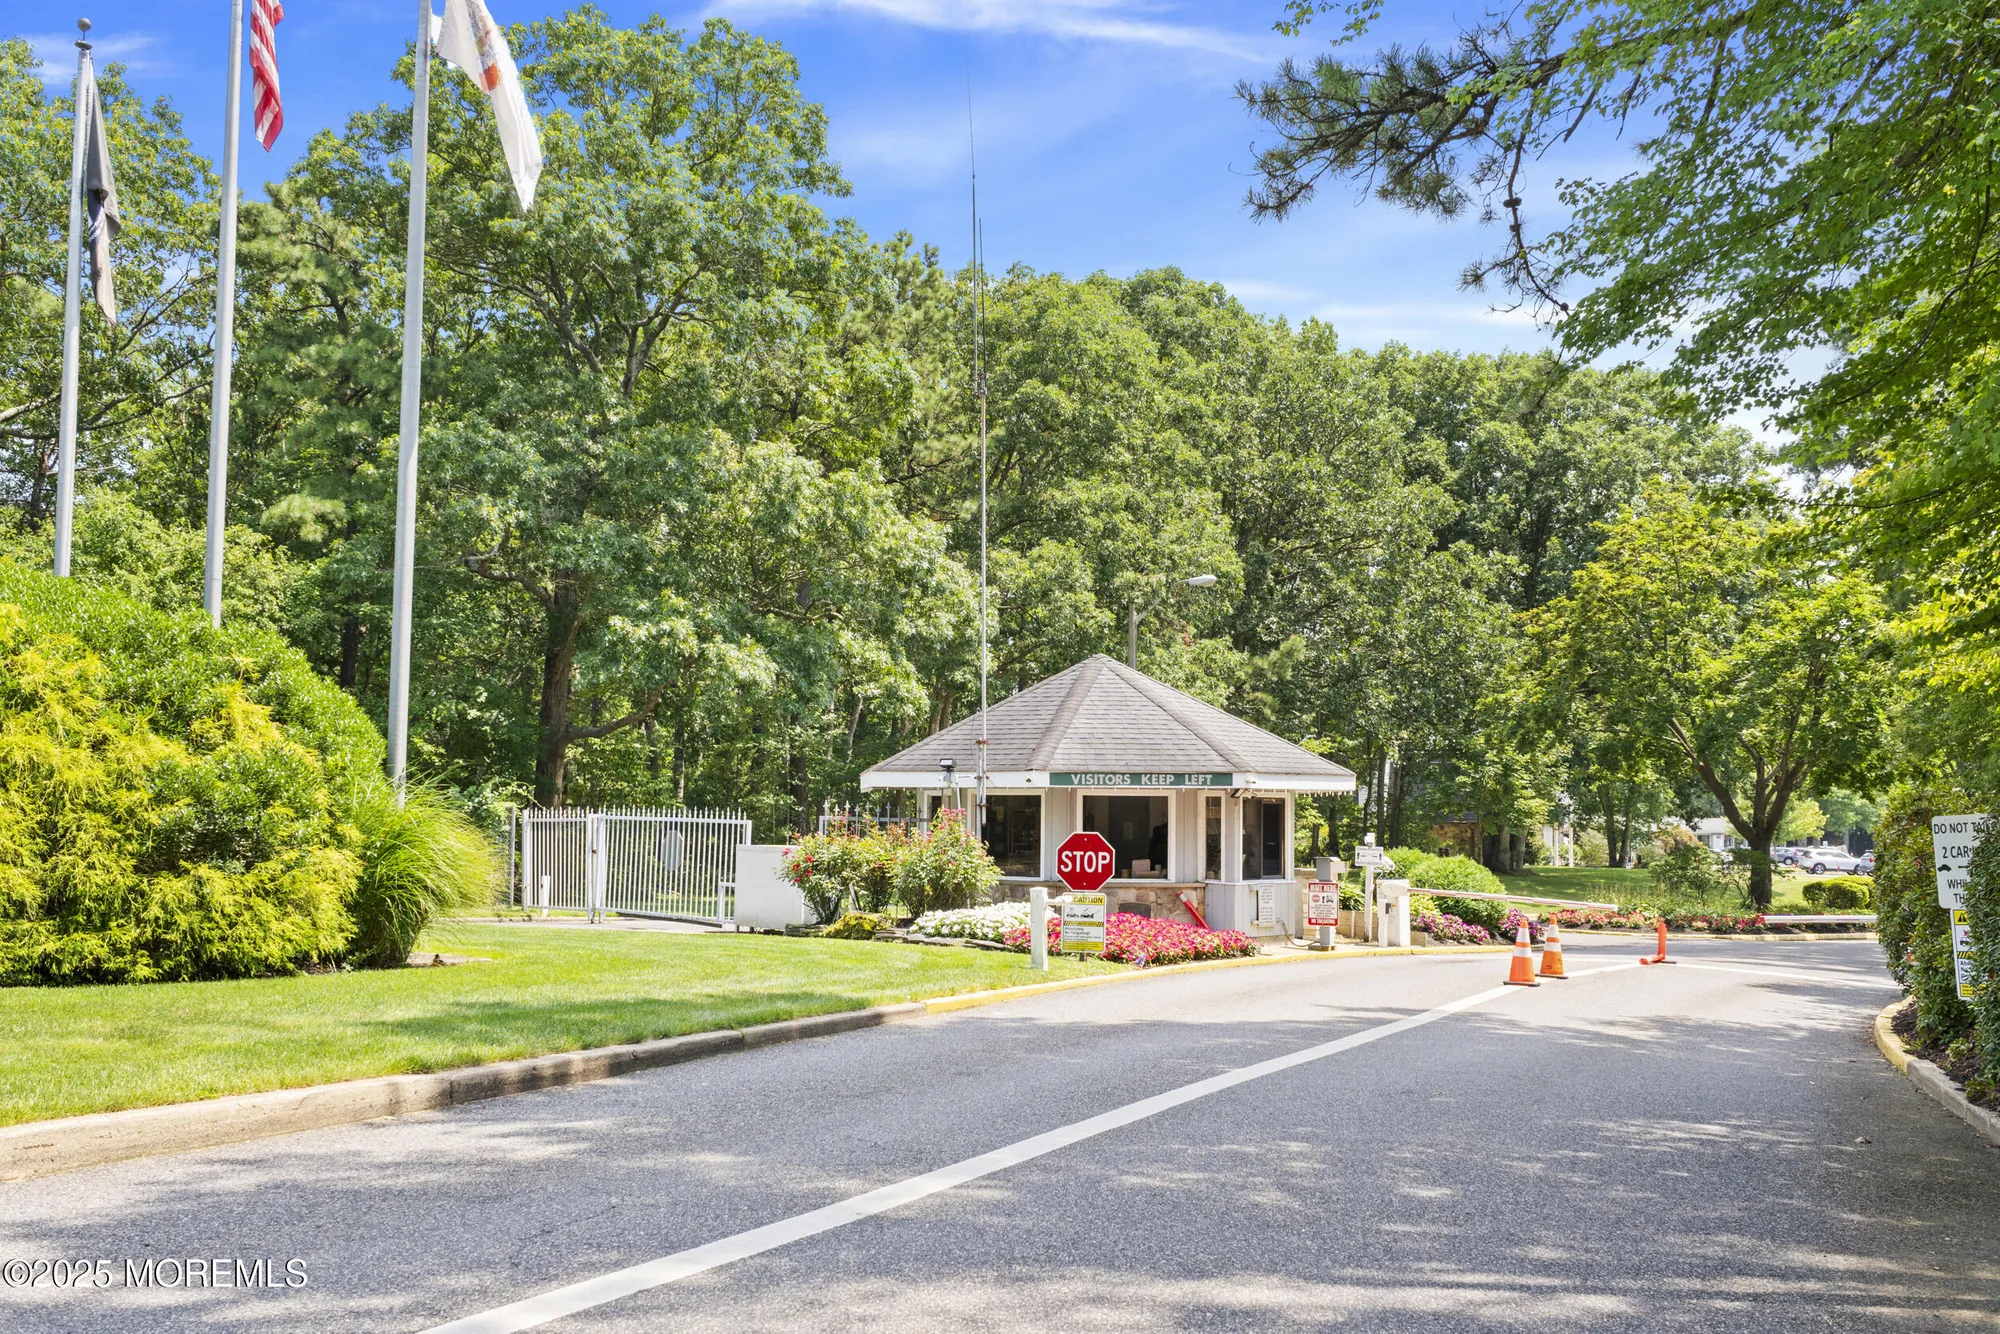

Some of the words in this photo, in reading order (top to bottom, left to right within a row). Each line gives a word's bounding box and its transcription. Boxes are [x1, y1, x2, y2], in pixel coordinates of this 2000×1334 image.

[1071, 774, 1131, 785] VISITORS
[1141, 774, 1174, 785] KEEP
[1185, 774, 1213, 785] LEFT
[1933, 824, 1947, 834] DO
[1949, 822, 1968, 833] NOT
[1942, 846, 1948, 858] 2
[1950, 846, 1972, 858] CAR
[1060, 850, 1111, 873] STOP
[1073, 896, 1103, 904] CAUTION
